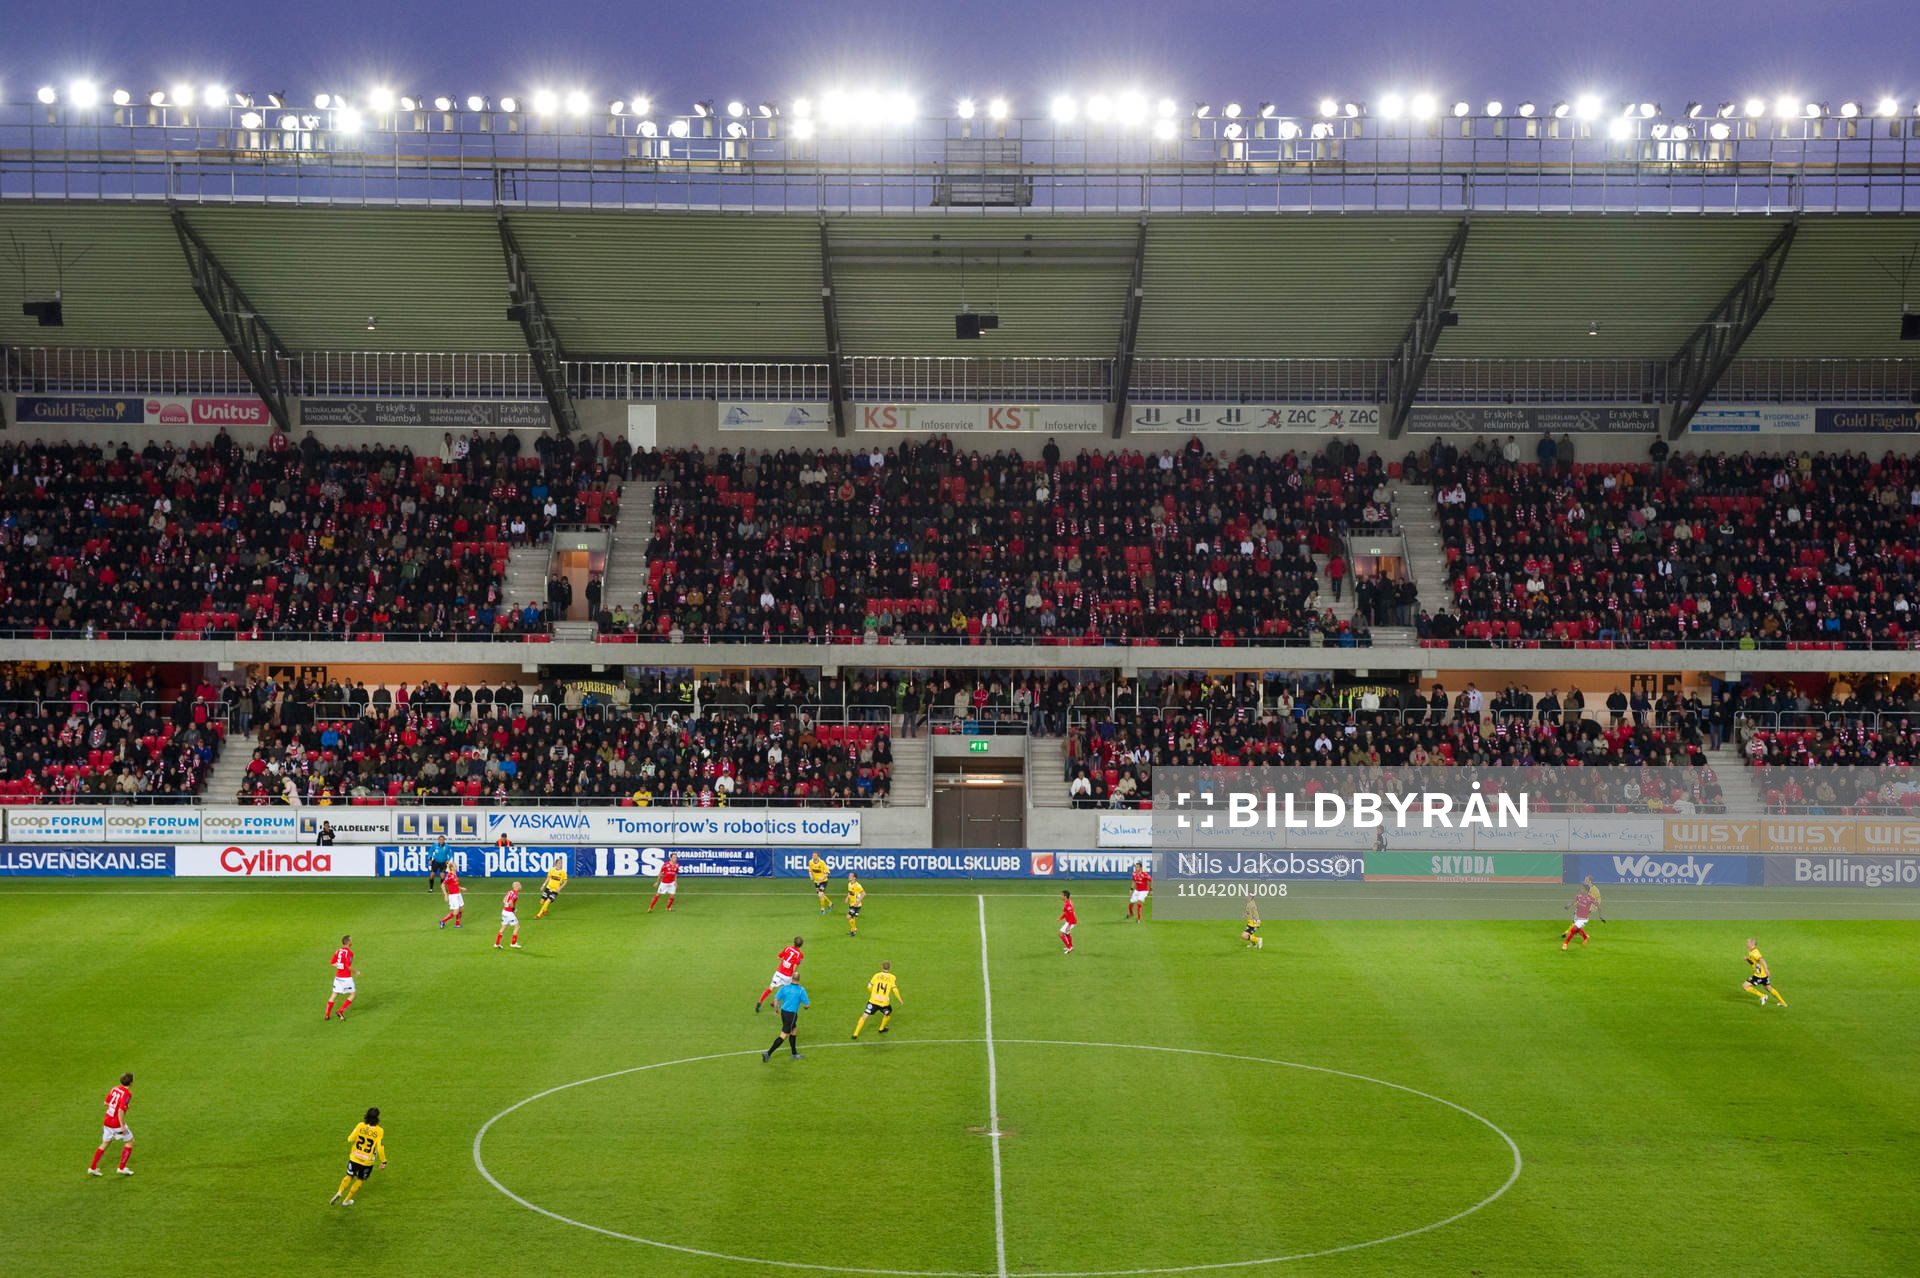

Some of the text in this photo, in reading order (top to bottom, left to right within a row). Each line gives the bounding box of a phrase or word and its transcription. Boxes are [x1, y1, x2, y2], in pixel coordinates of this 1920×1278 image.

[34, 403, 68, 417] Guld
[199, 404, 260, 420] Unitus
[375, 403, 385, 412] Er
[500, 404, 510, 413] Er
[1484, 410, 1493, 418] Er
[1609, 410, 1618, 419] Er
[375, 413, 422, 425] reklambyrå
[500, 415, 546, 425] reklambyrå
[864, 406, 974, 430] KST Infoservice
[988, 407, 1098, 431] KST Infoservice
[1287, 409, 1316, 424] ZAC
[1350, 409, 1378, 424] ZAC
[1833, 412, 1867, 428] Guld
[1484, 420, 1530, 430] reklambyrå
[1609, 420, 1655, 431] reklambyrå
[10, 816, 103, 828] coop FORUM
[107, 817, 199, 828] coop FORUM
[203, 817, 295, 828] coop FORUM
[511, 814, 590, 829] YASKAWA
[723, 818, 797, 833] robotics
[1102, 822, 1146, 836] Kalmar
[1672, 824, 1750, 842] WISY
[1768, 825, 1847, 844] WISY
[220, 846, 331, 875] Cylinda
[384, 846, 467, 876] plåtn
[485, 846, 568, 877] plåtson
[594, 848, 666, 876] IBS
[785, 855, 1020, 871] HEL SVERIGES FOTBOLLSKLUBB
[1431, 855, 1495, 874] SKYDDA
[1612, 855, 1714, 885] Woody
[876, 982, 888, 995] 14
[356, 1135, 375, 1154] 23
